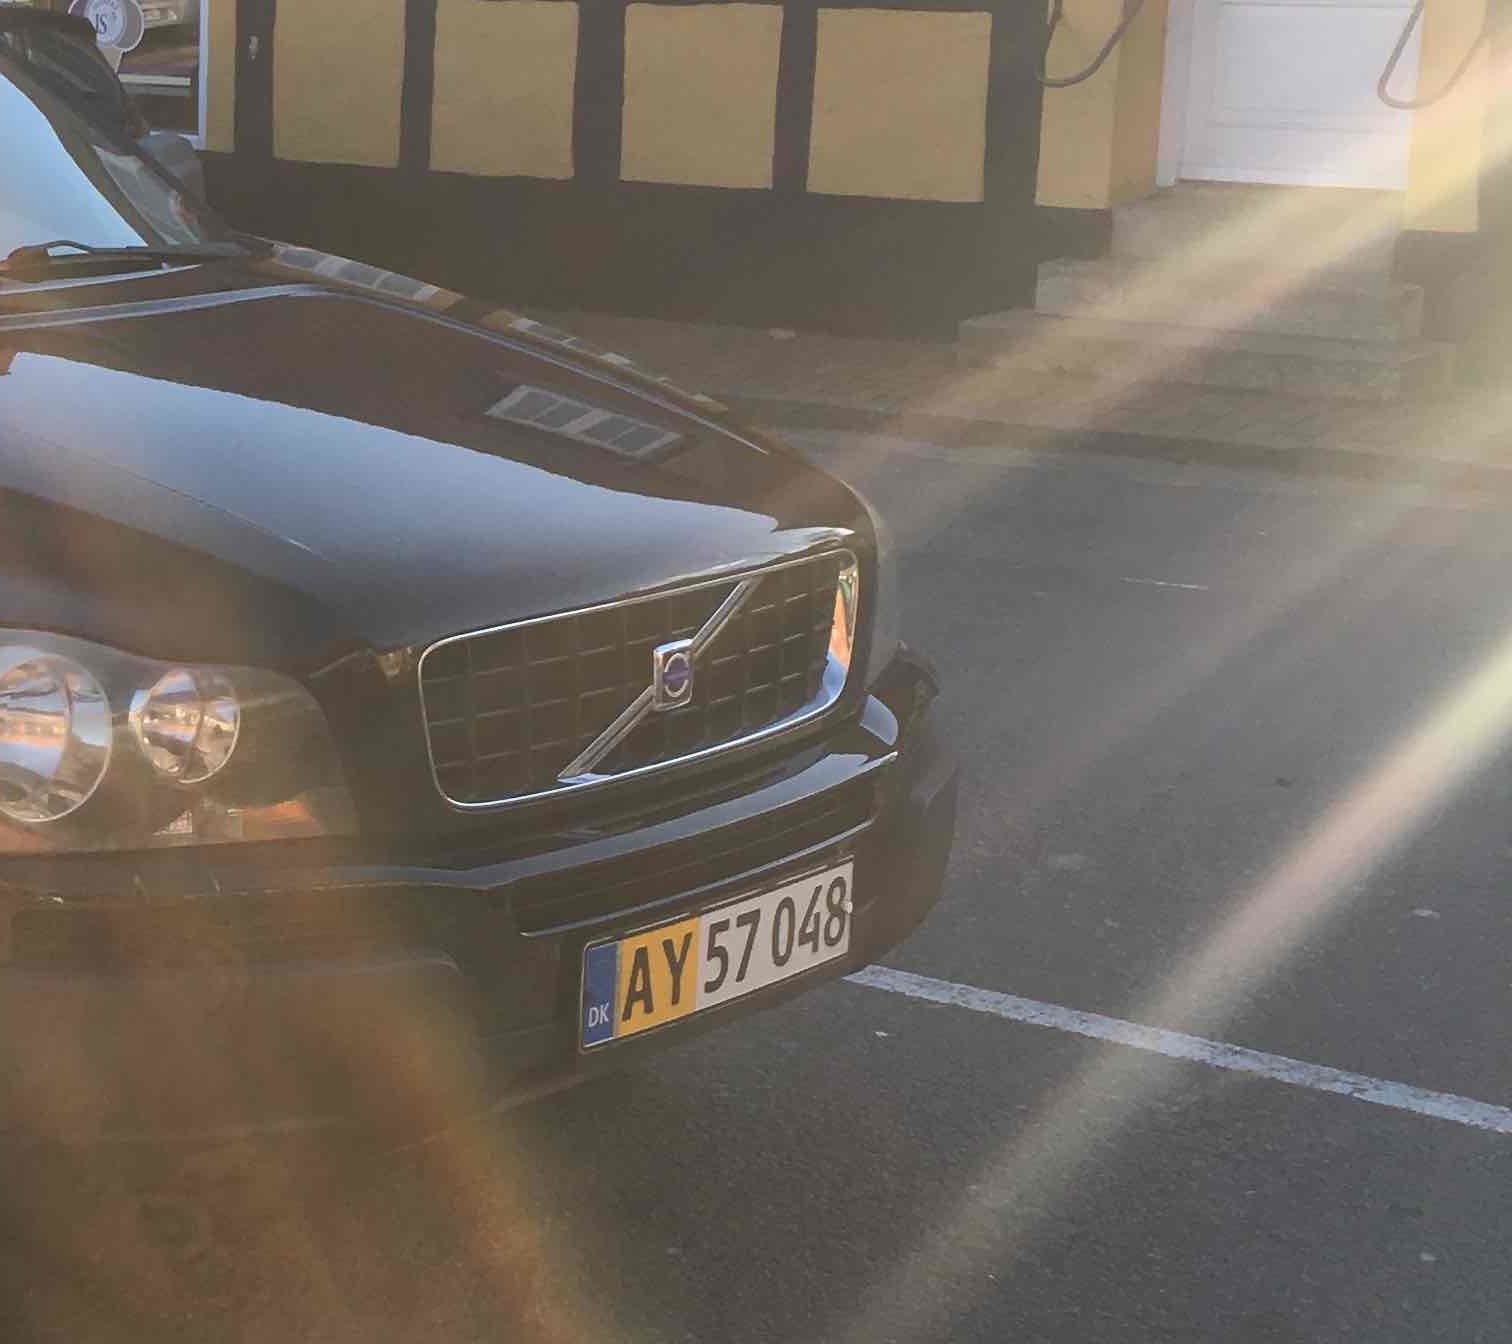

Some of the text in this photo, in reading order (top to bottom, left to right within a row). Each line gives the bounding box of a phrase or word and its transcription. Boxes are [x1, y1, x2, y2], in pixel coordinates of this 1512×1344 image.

[621, 875, 848, 1022] AY 57 048
[588, 1002, 609, 1028] DK
